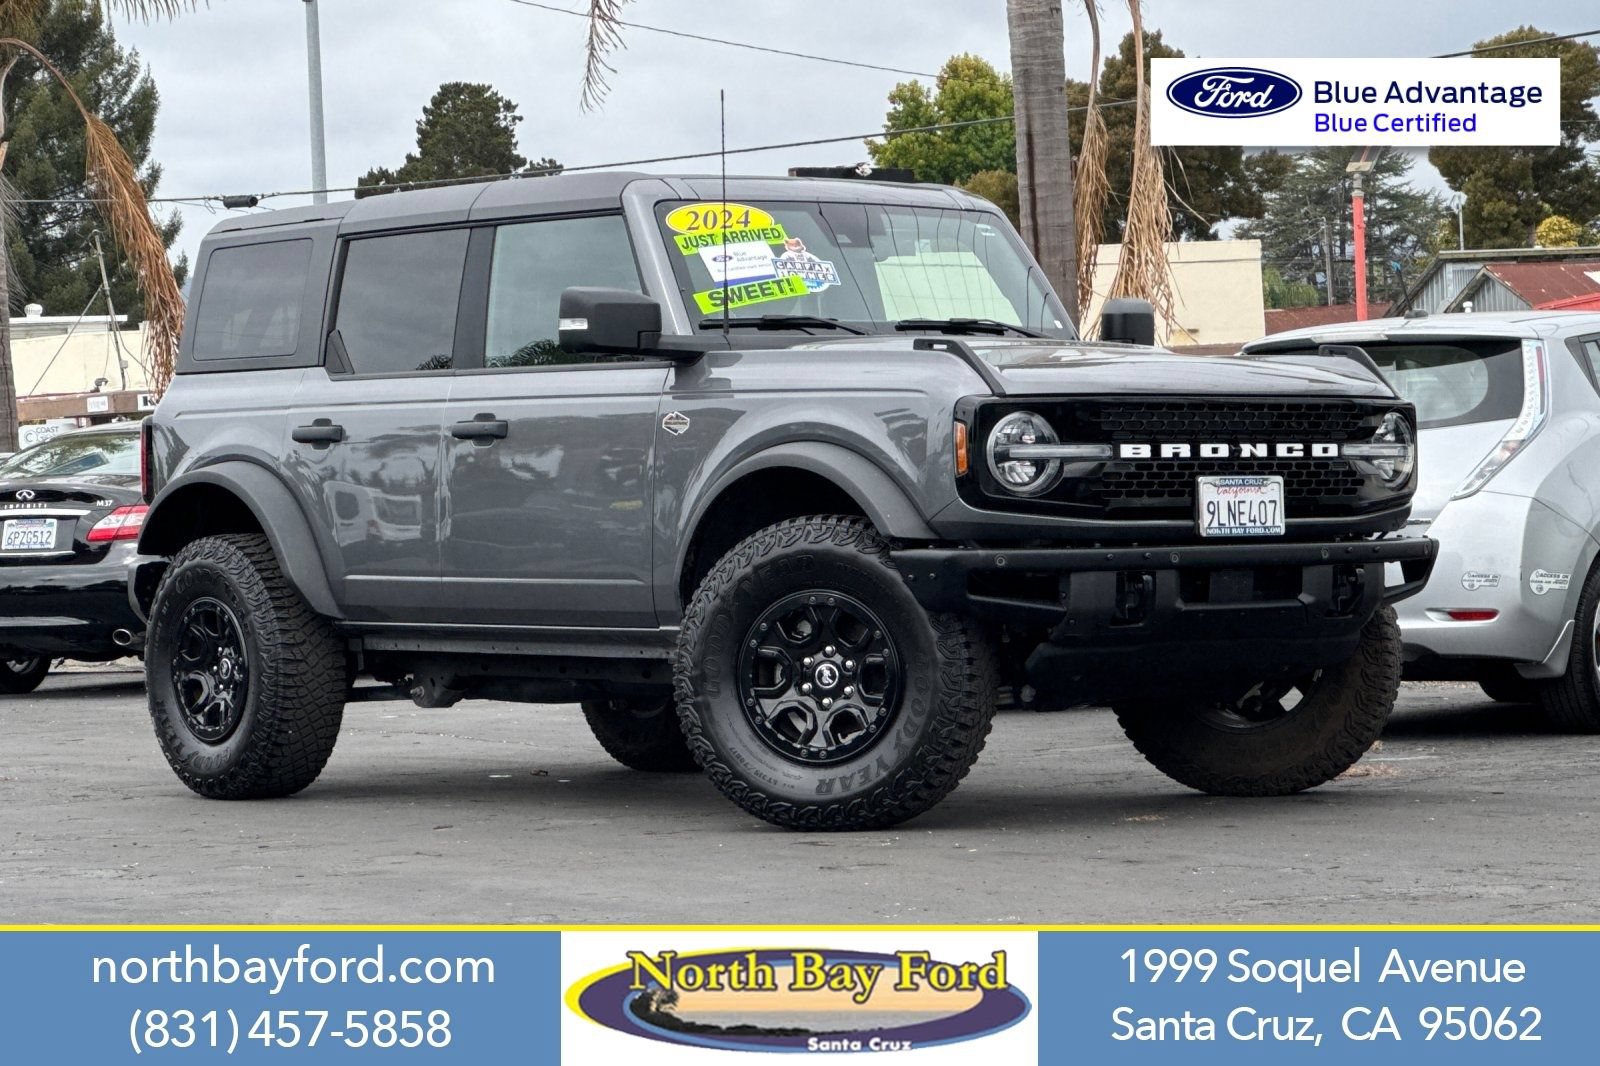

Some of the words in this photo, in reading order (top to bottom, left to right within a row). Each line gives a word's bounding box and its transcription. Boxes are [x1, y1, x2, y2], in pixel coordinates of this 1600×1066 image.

[686, 209, 751, 231] 2024
[682, 234, 716, 250] JUST
[722, 227, 782, 244] ARRIVED
[775, 261, 832, 273] CARFAX
[708, 278, 795, 306] SWEET!
[36, 425, 59, 434] COAST
[1120, 443, 1339, 458] BRONCO
[1216, 486, 1268, 498] California
[1206, 499, 1278, 527] 9LNE407
[6, 530, 53, 546] 6PZG512
[1206, 527, 1230, 535] NORTH
[1231, 527, 1245, 535] BAY
